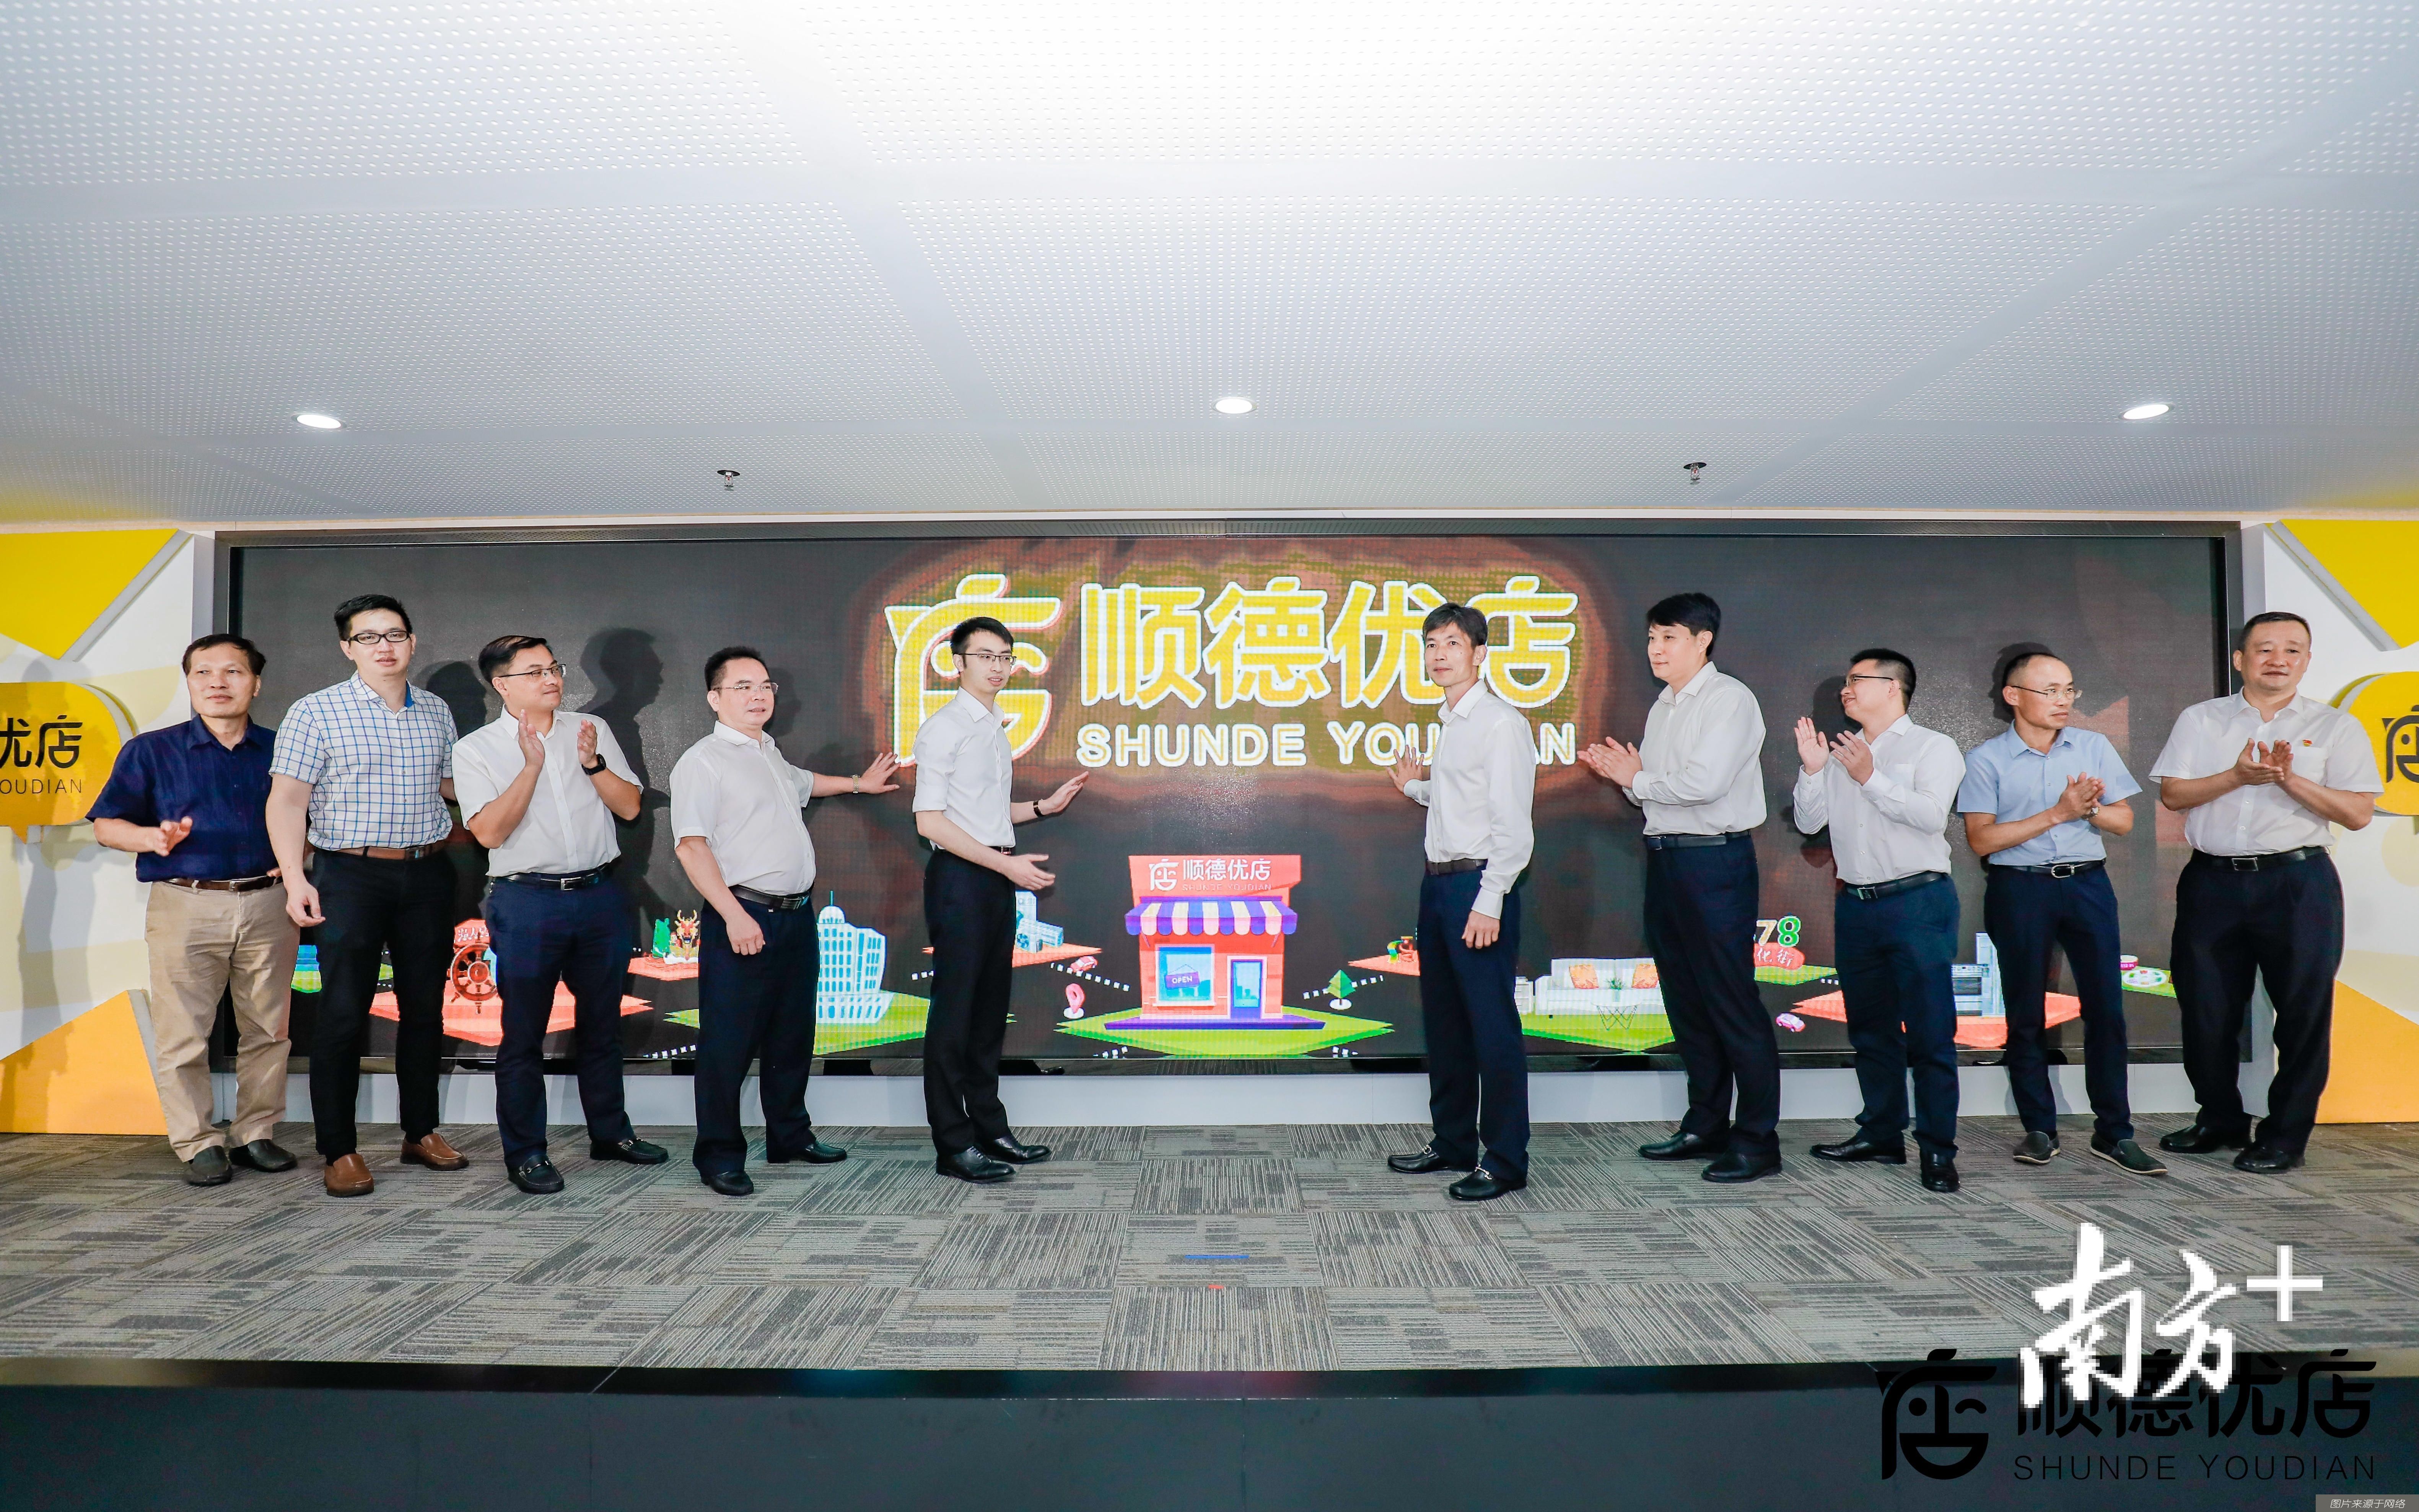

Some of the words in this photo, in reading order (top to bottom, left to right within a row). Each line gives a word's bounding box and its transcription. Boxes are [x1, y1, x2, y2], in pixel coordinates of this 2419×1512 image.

[1081, 576, 1579, 710] 顺德优店
[1076, 724, 1307, 767] SHUNDE
[1327, 721, 1576, 765] YOUN
[1183, 858, 1271, 881] 顺德优店
[1754, 915, 1802, 947] 78
[1171, 976, 1193, 984] OPEN
